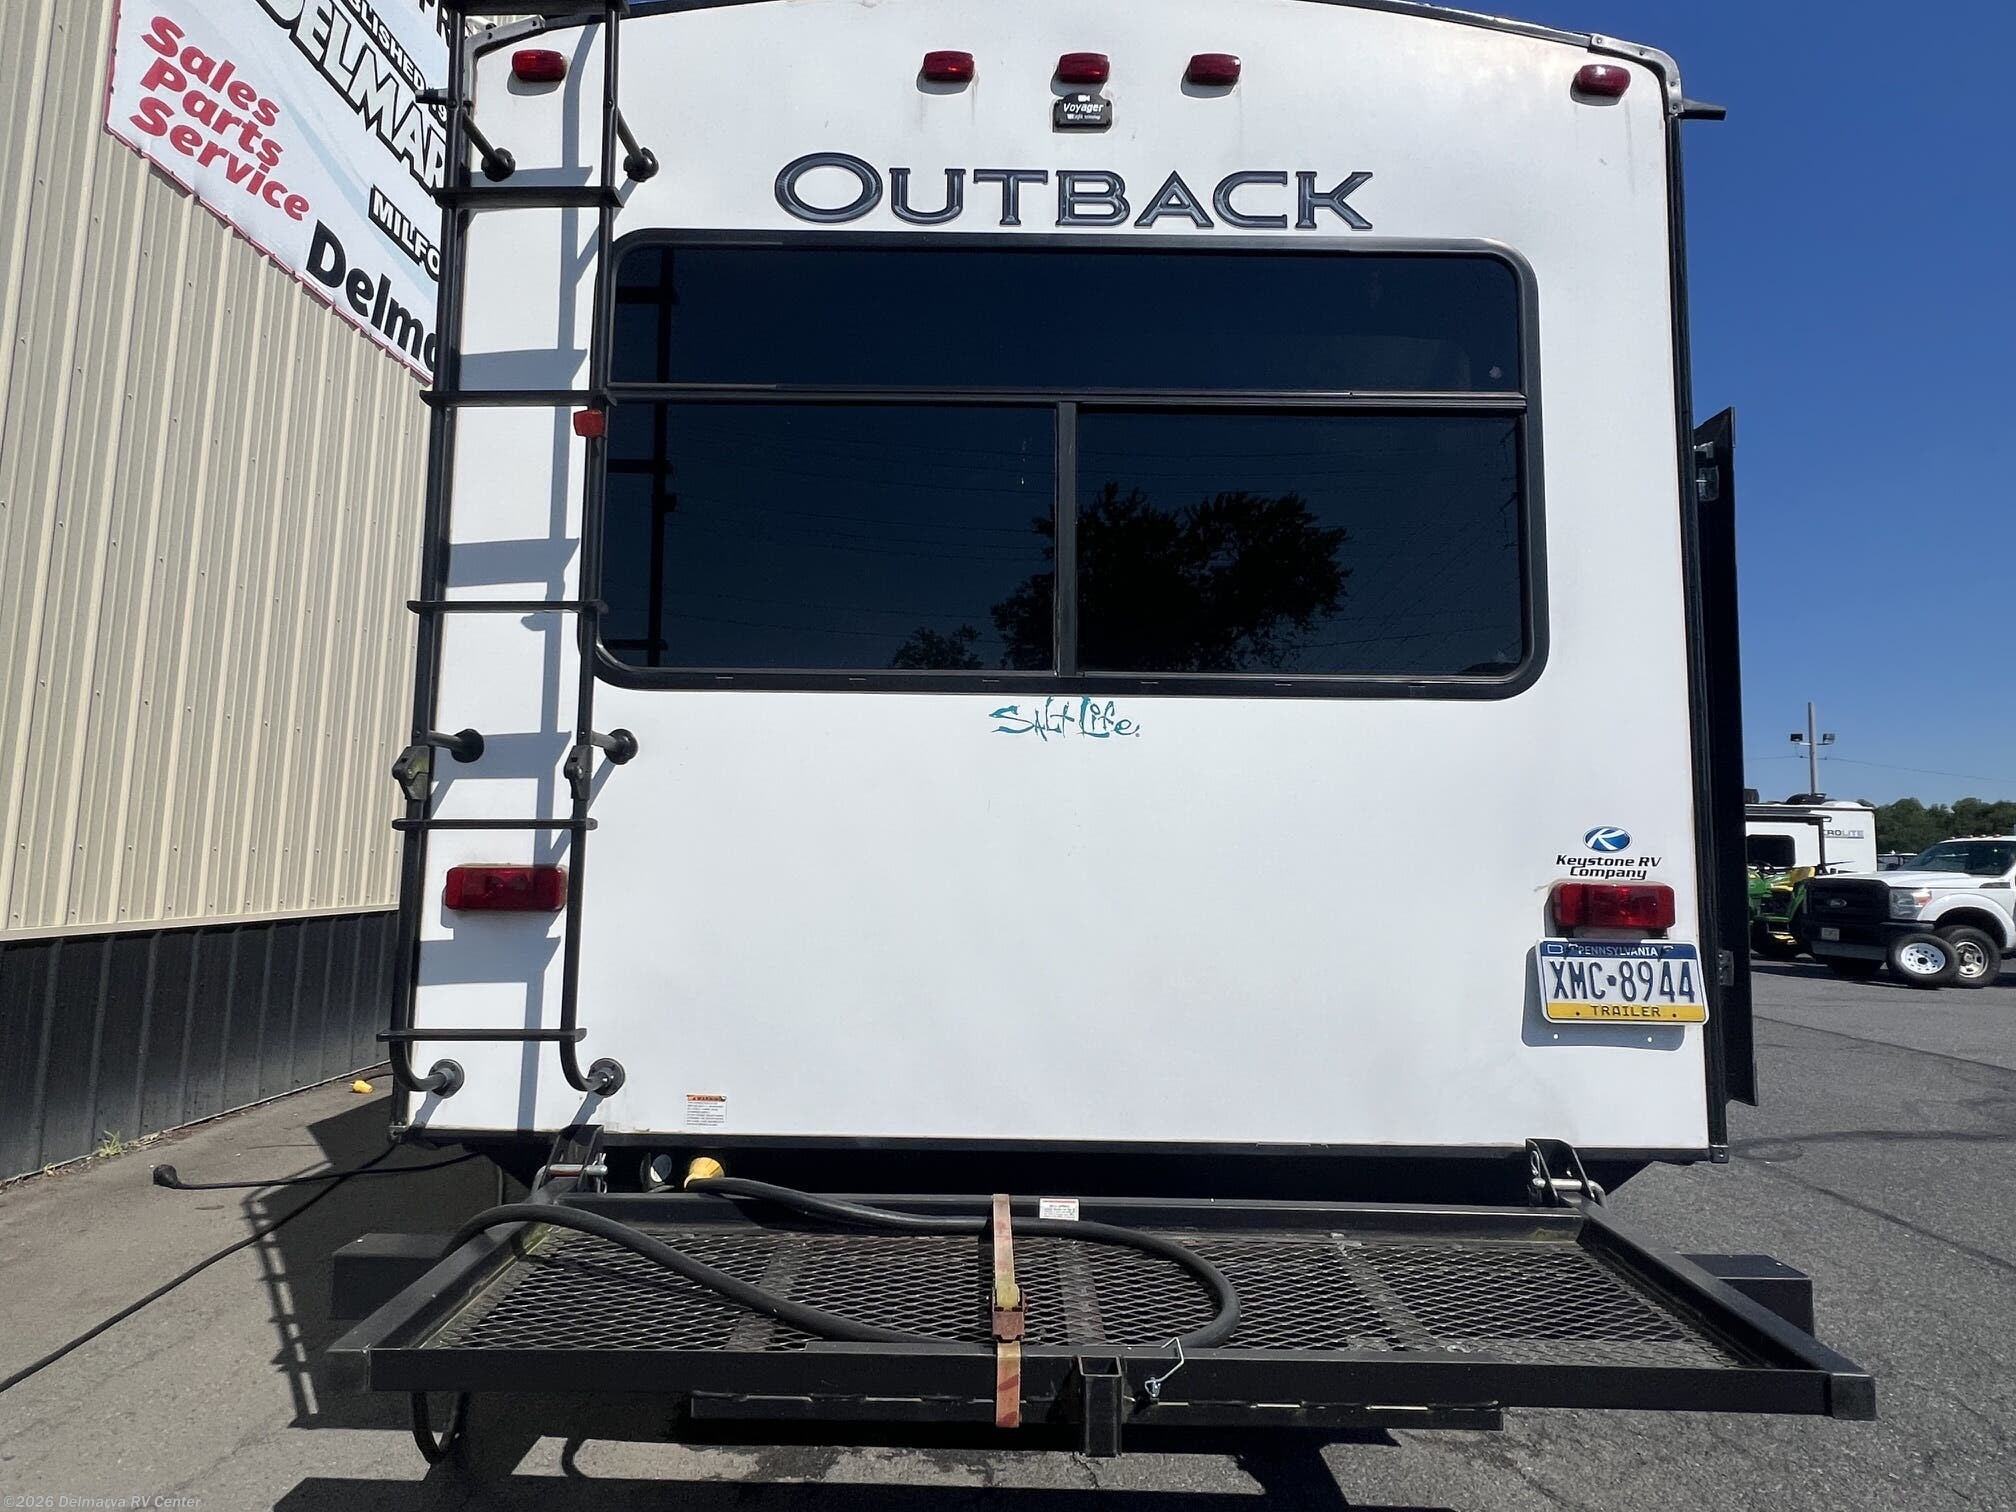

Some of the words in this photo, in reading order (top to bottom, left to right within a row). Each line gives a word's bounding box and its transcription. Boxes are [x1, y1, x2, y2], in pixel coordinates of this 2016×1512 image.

[141, 16, 281, 127] Sales
[139, 57, 284, 168] Parts
[1063, 103, 1104, 113] Voyager
[129, 97, 310, 221] Service
[774, 151, 1375, 231] OUTBACK
[1556, 855, 1635, 868] Keystone
[1638, 856, 1662, 867] RV
[1570, 866, 1647, 881] Company
[1578, 945, 1659, 957] PENNSYLVANIA
[1591, 1005, 1661, 1017] TRAILER
